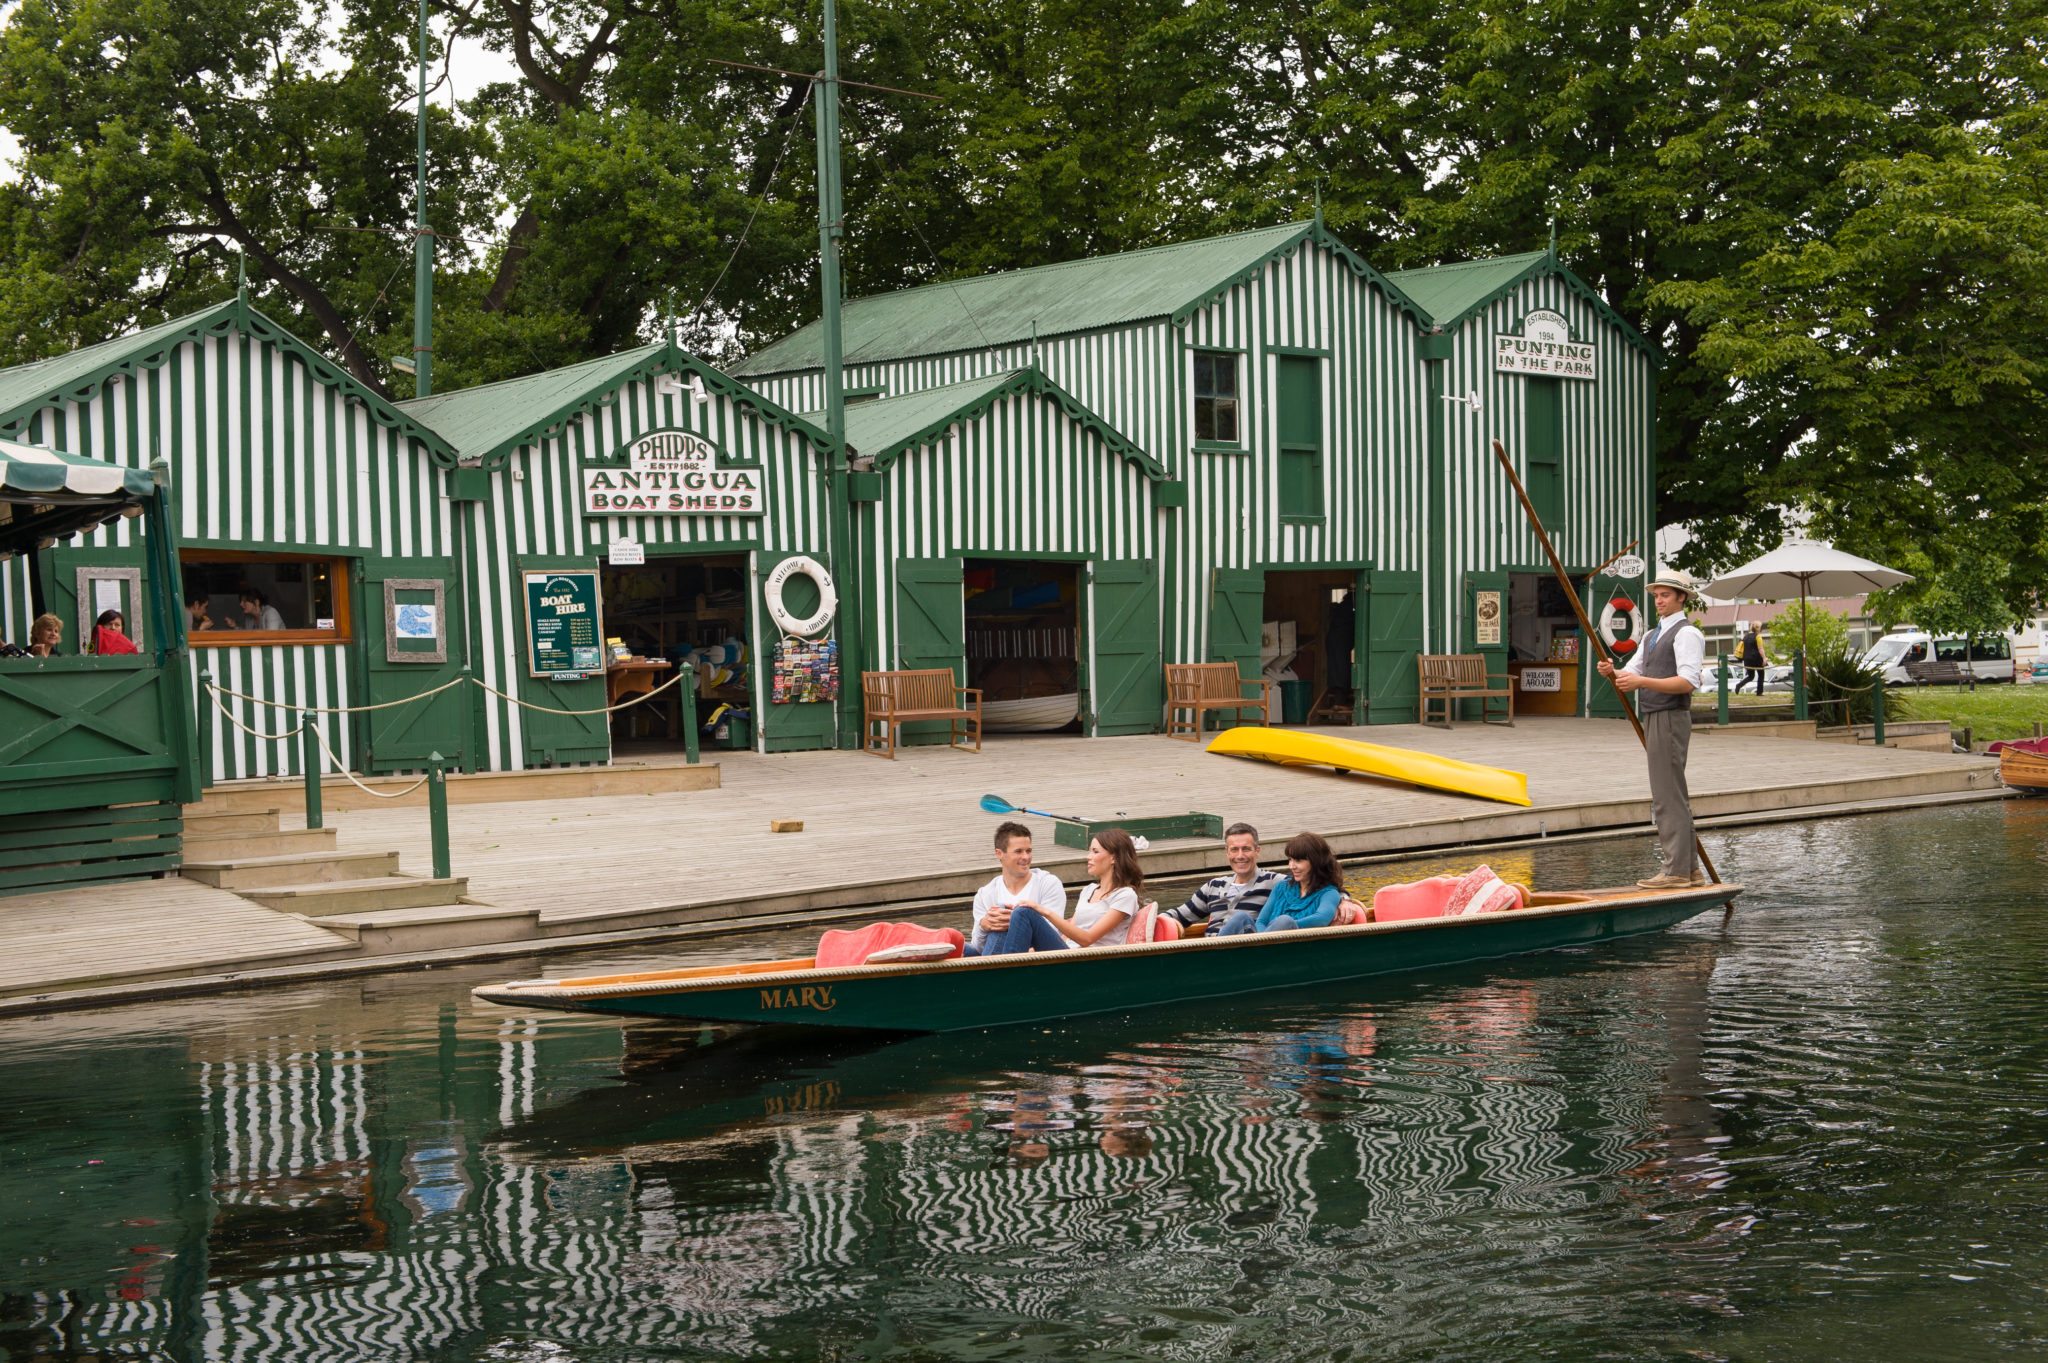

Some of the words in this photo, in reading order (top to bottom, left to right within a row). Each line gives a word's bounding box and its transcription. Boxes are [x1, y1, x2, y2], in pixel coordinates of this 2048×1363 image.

[1527, 313, 1567, 330] ESTABLISHED
[1539, 331, 1555, 341] 1994
[1499, 338, 1592, 361] PUNTING
[1498, 355, 1515, 368] IN
[1520, 357, 1548, 371] THE
[1554, 361, 1593, 375] PARK
[637, 434, 708, 461] PHIPPS
[679, 462, 700, 470] 1882
[588, 471, 757, 491] ANTIGUA
[592, 493, 661, 510] BOAT
[668, 493, 753, 510] SHEDS
[775, 560, 799, 583] WELCOME
[1622, 565, 1641, 575] HERE
[540, 594, 573, 607] BOAT
[555, 602, 586, 615] HIRE
[808, 612, 829, 631] ABOARD
[1525, 671, 1556, 679] WELCOME
[1525, 679, 1556, 688] ABOARD
[760, 985, 837, 1011] MARY
